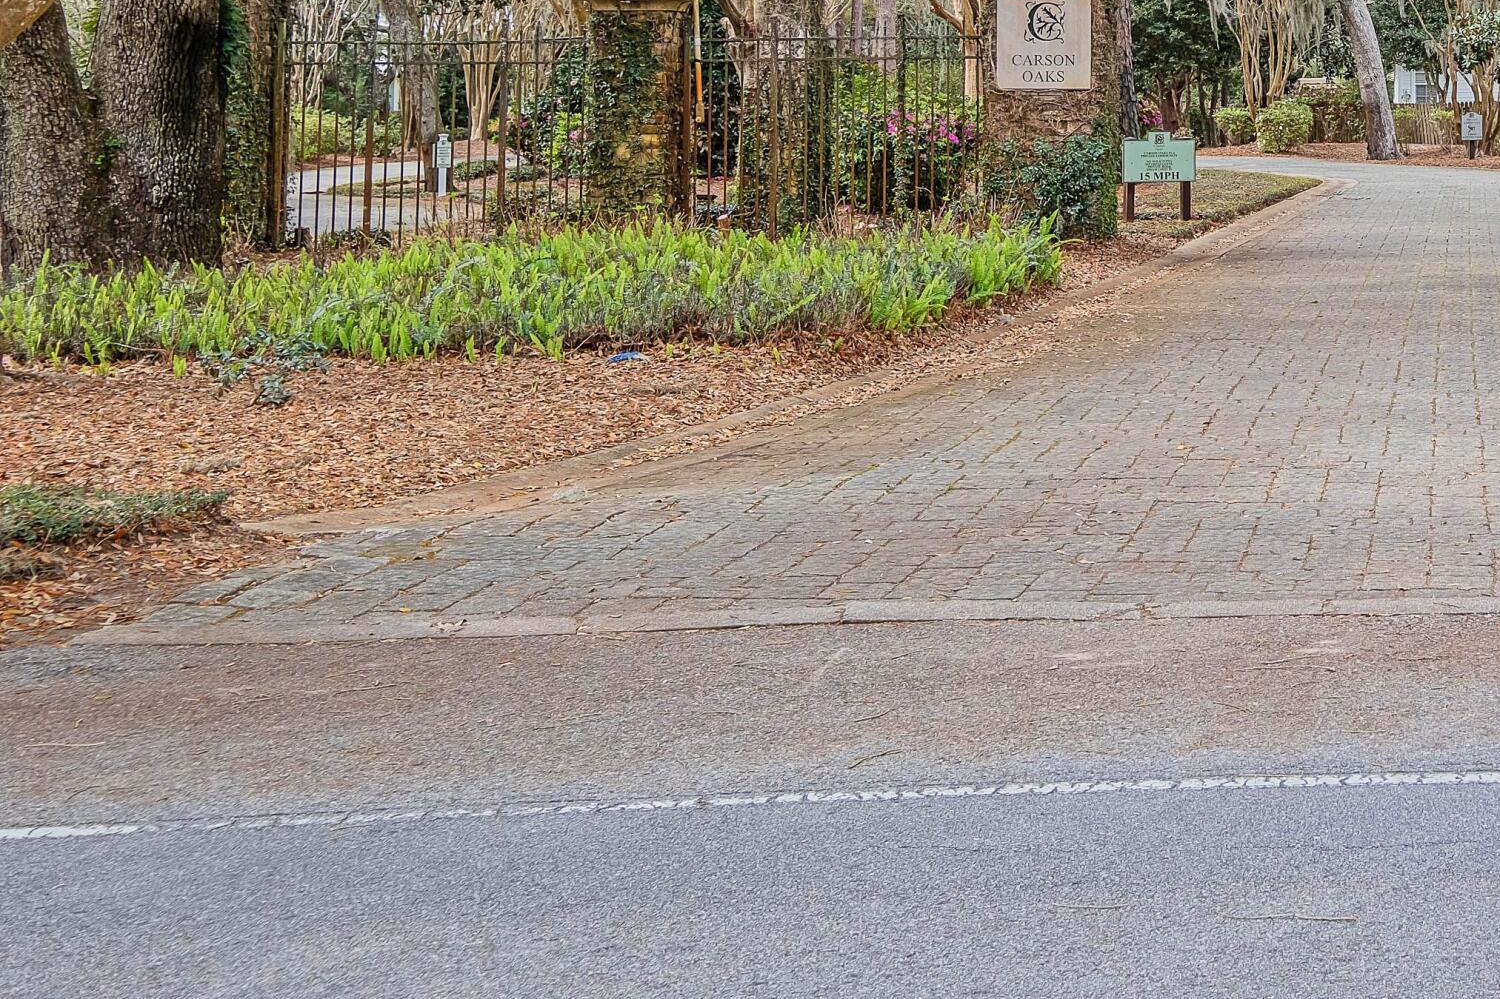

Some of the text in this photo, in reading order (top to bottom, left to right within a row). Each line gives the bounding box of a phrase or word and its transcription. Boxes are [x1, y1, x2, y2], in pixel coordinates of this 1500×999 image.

[1012, 54, 1075, 66] CARSON
[1022, 70, 1065, 82] OAKS
[1140, 171, 1180, 180] 15 MPH
